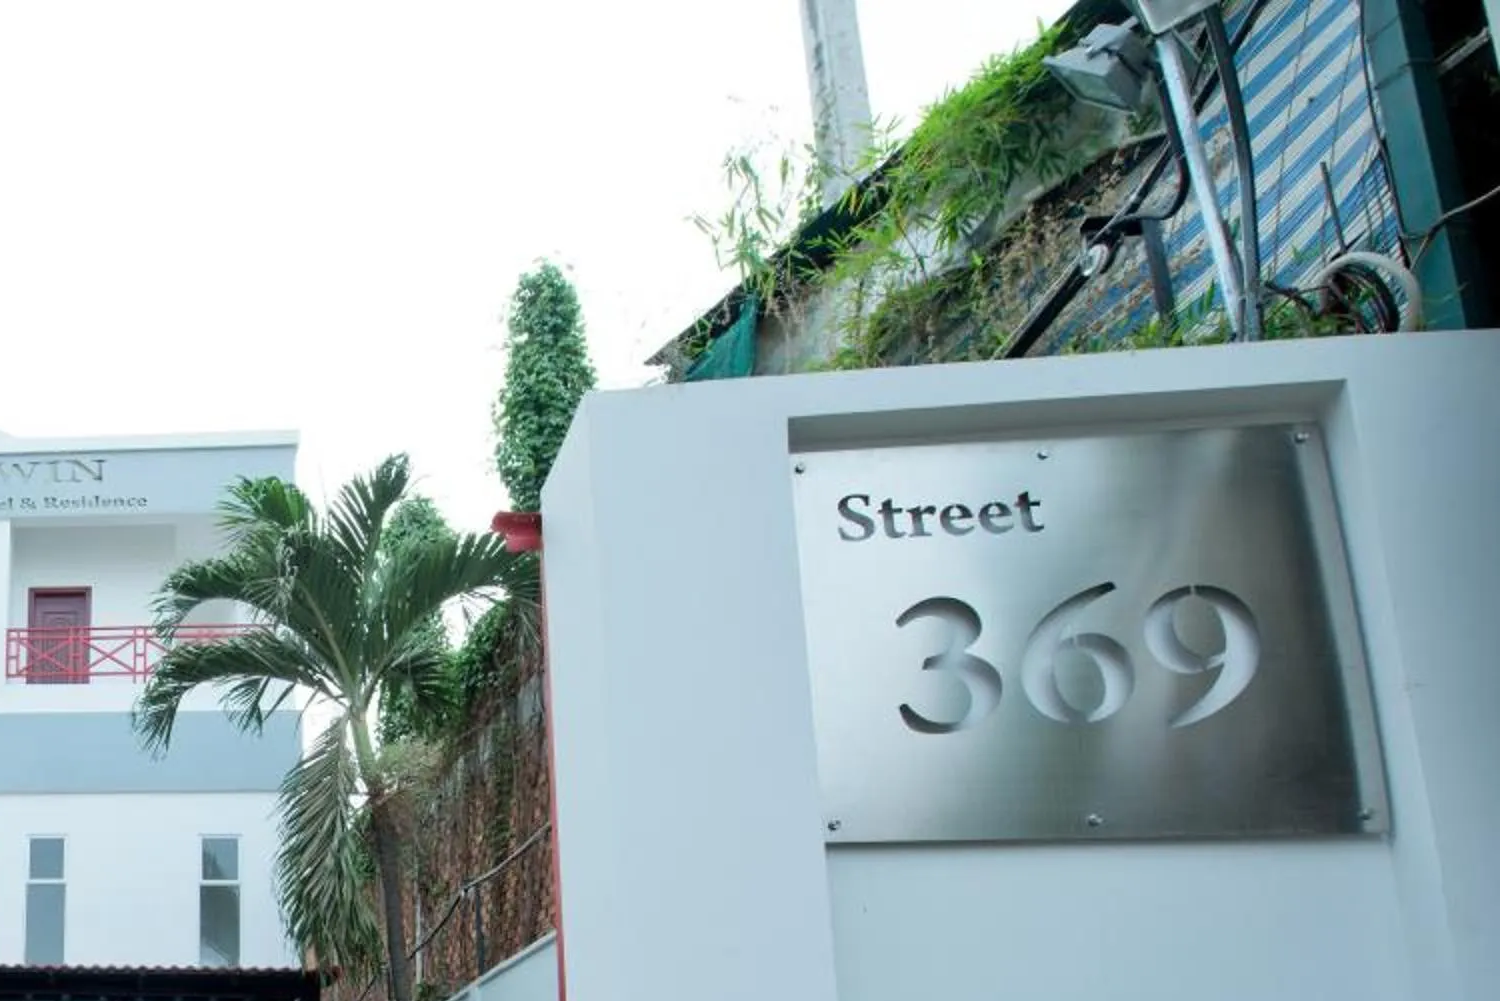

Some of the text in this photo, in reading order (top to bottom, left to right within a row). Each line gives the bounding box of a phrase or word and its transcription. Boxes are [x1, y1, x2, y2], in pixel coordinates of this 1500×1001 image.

[19, 496, 37, 510] &
[43, 493, 148, 510] Residence
[837, 491, 1045, 541] Street
[895, 581, 1261, 734] 369
